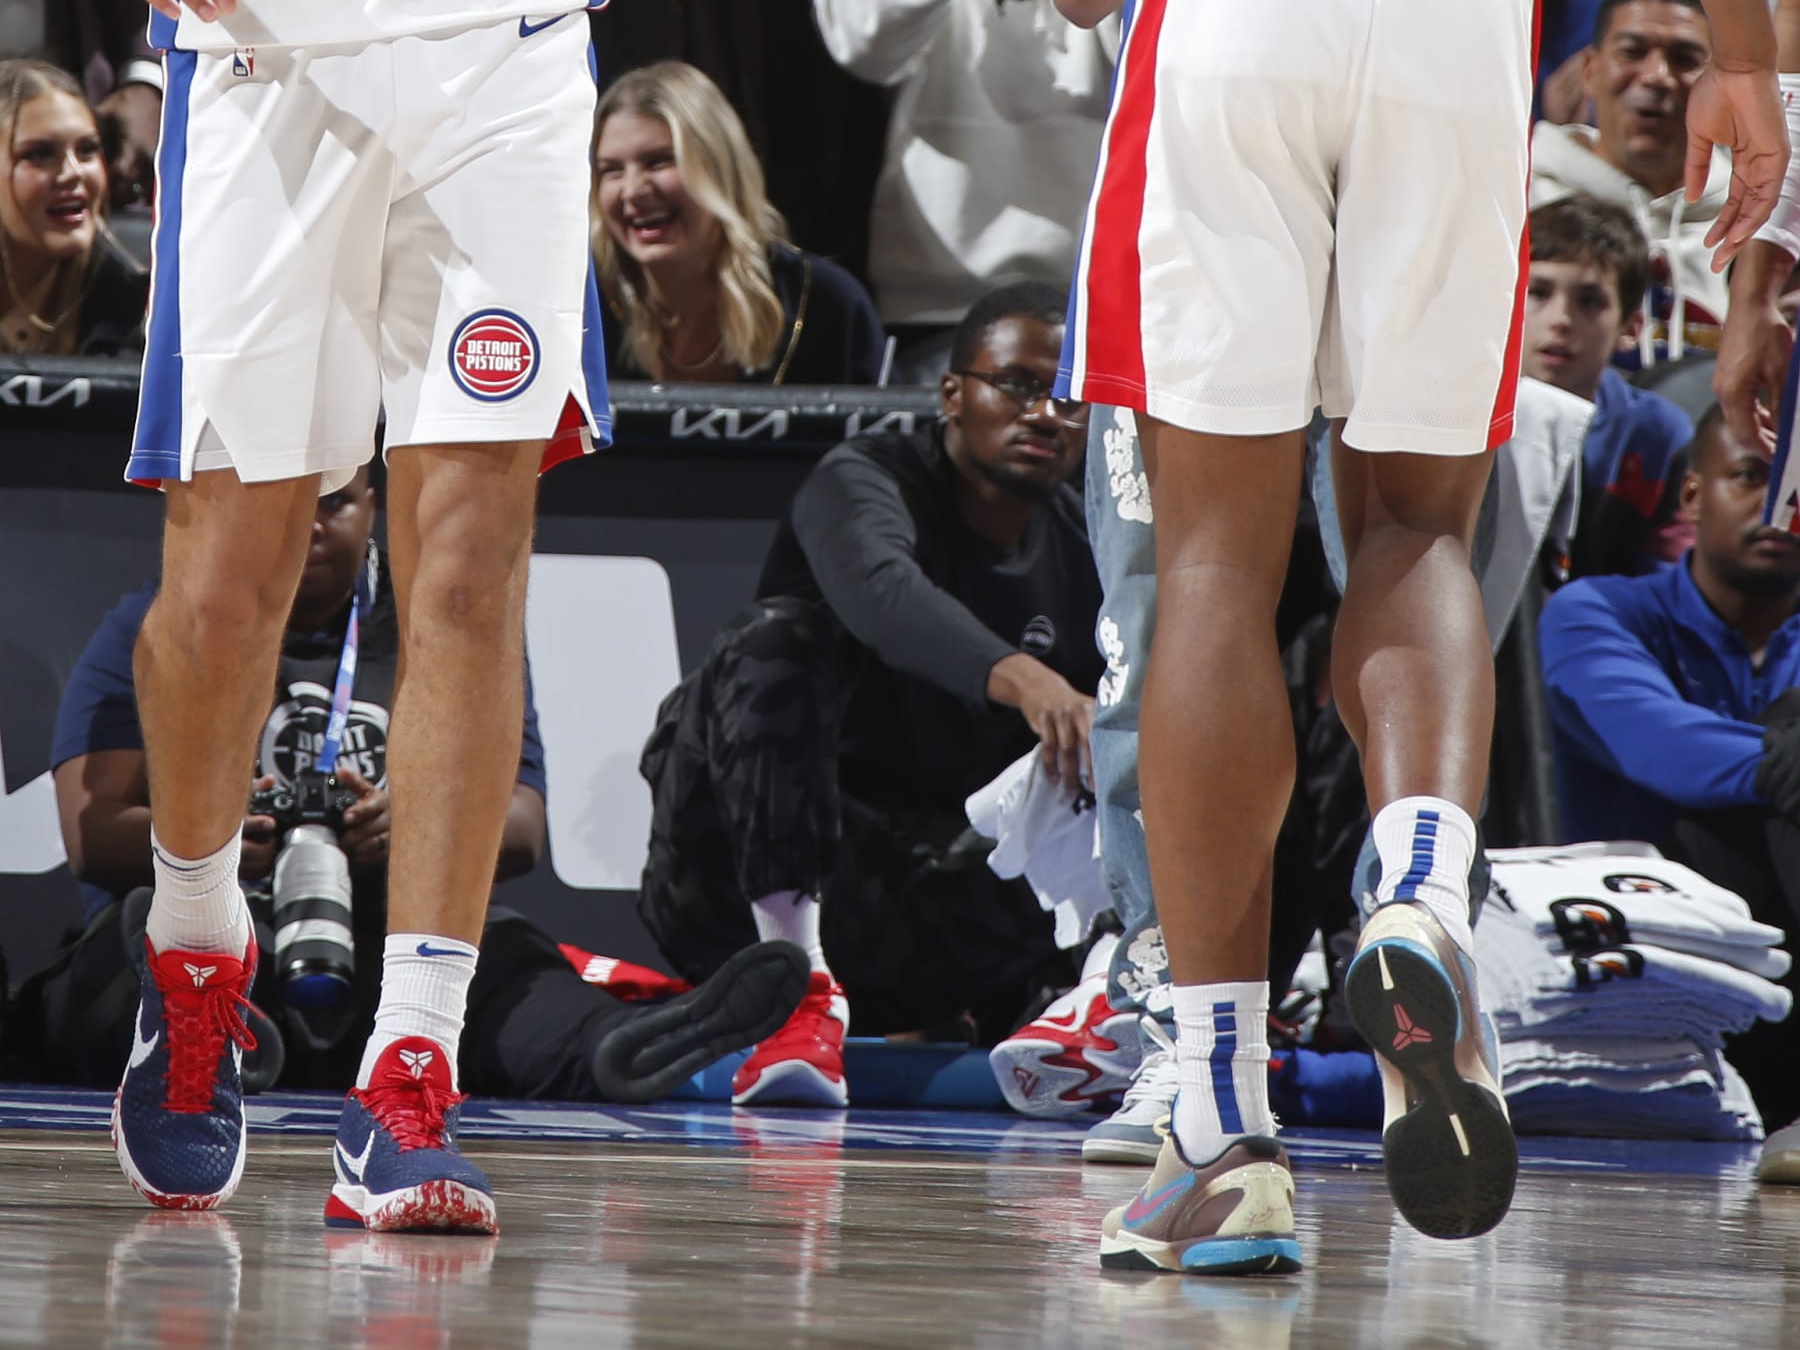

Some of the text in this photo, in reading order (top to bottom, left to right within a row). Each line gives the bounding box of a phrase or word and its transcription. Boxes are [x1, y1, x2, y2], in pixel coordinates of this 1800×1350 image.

[466, 339, 522, 356] DETROIT
[465, 355, 522, 372] PISTONS
[670, 406, 790, 440] KIA
